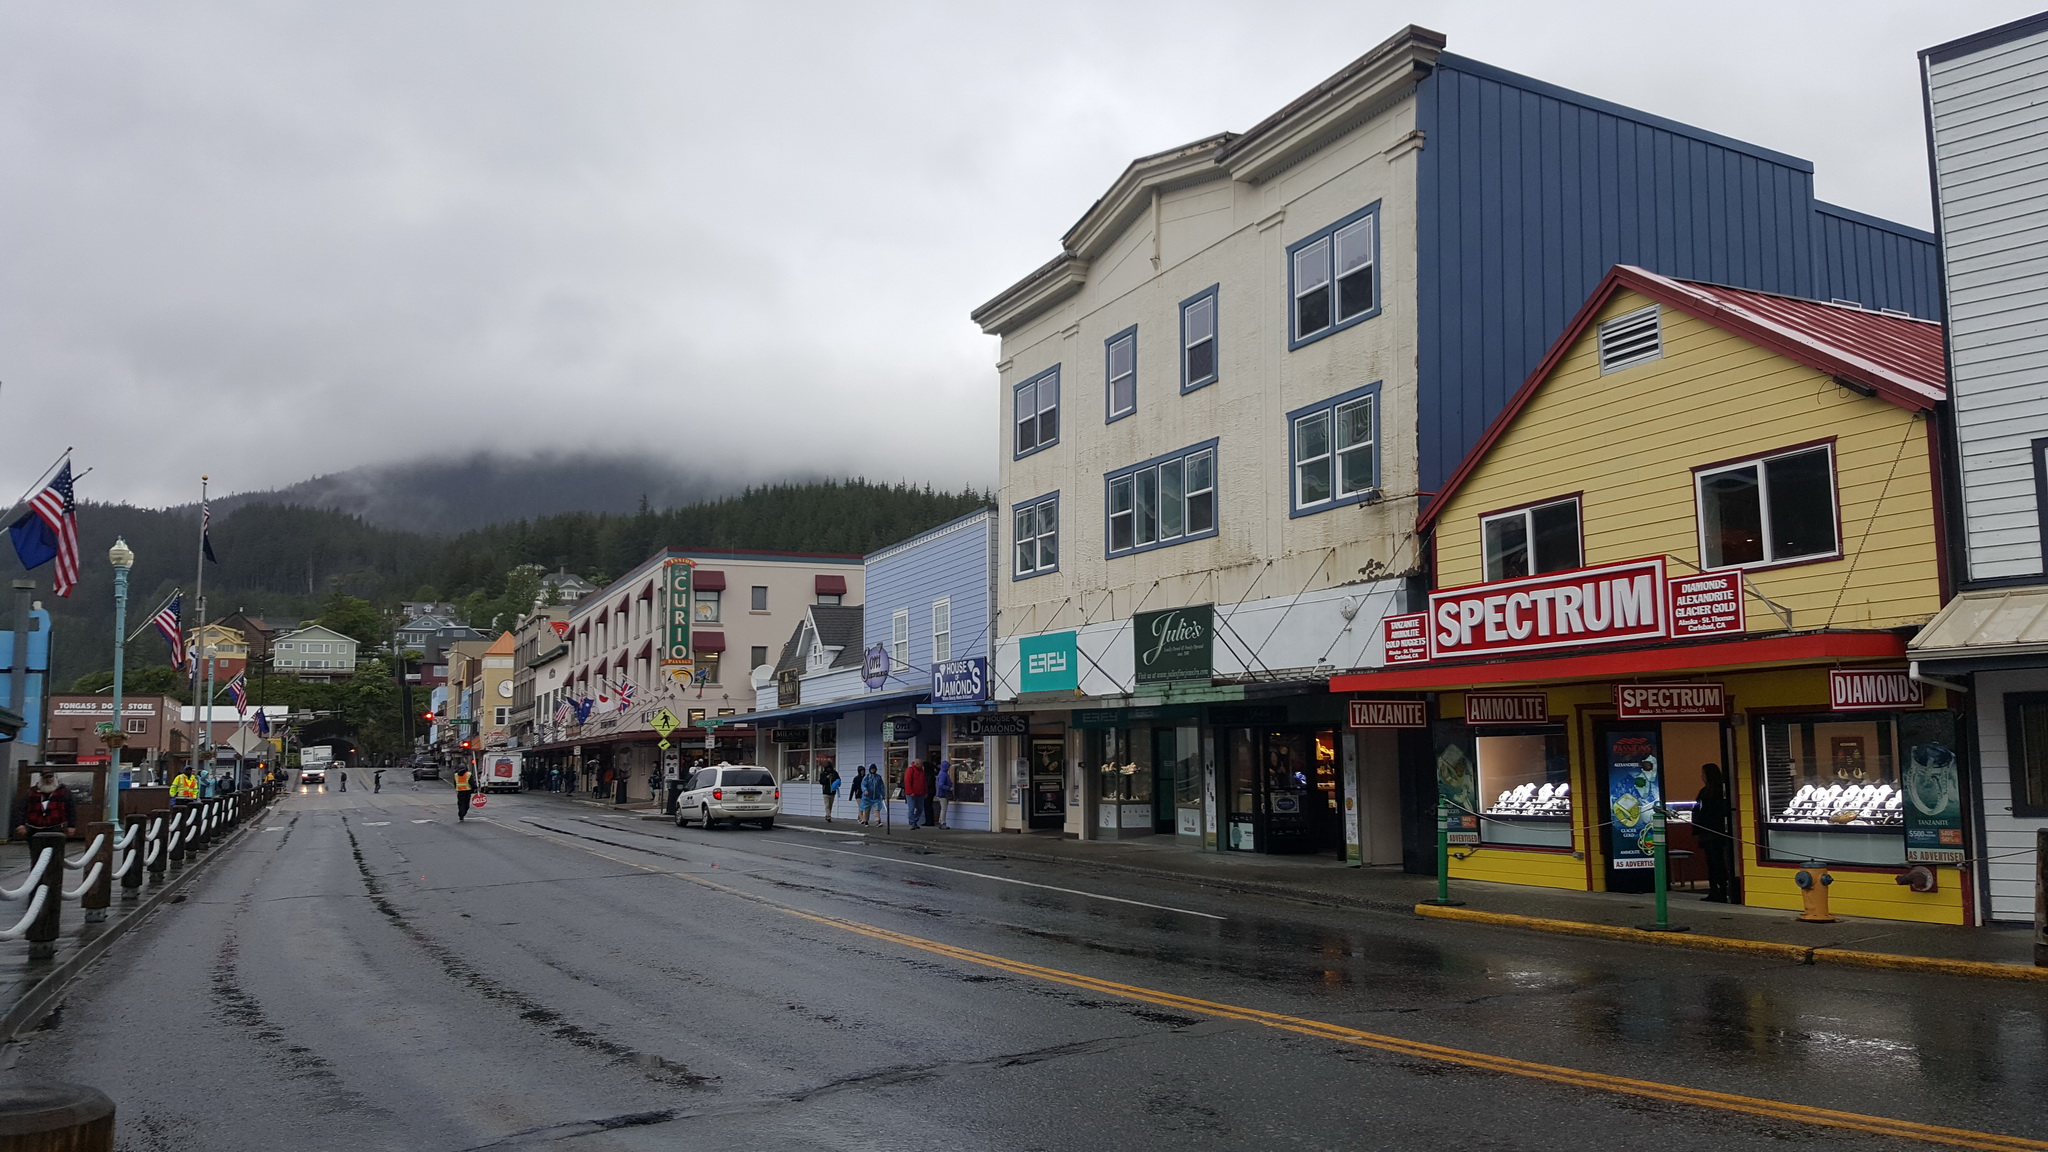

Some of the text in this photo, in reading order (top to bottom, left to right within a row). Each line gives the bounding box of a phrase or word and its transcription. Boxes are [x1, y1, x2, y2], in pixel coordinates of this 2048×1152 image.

[1681, 579, 1728, 593] DIAMONDS
[1676, 589, 1735, 606] ALEXANDRITE
[671, 576, 687, 659] CURIO
[1437, 574, 1655, 647] SPECTRUM
[1675, 602, 1737, 618] GLACIER GOLD
[1142, 610, 1205, 666] Julie's
[946, 660, 967, 674] HOUSE
[934, 667, 981, 698] DIAMONDS
[1834, 674, 1919, 704] DIAMONDS
[1622, 688, 1720, 708] SPECTRUM
[1353, 704, 1423, 724] TANZANITE
[1470, 698, 1544, 720] AMMOLITE
[970, 718, 1025, 734] DIAMONDS
[1613, 743, 1652, 754] PASSIONS
[472, 796, 487, 804] STOP
[1449, 834, 1478, 842] ADVERTISED
[1908, 851, 1964, 862] AS ADVERTISED
